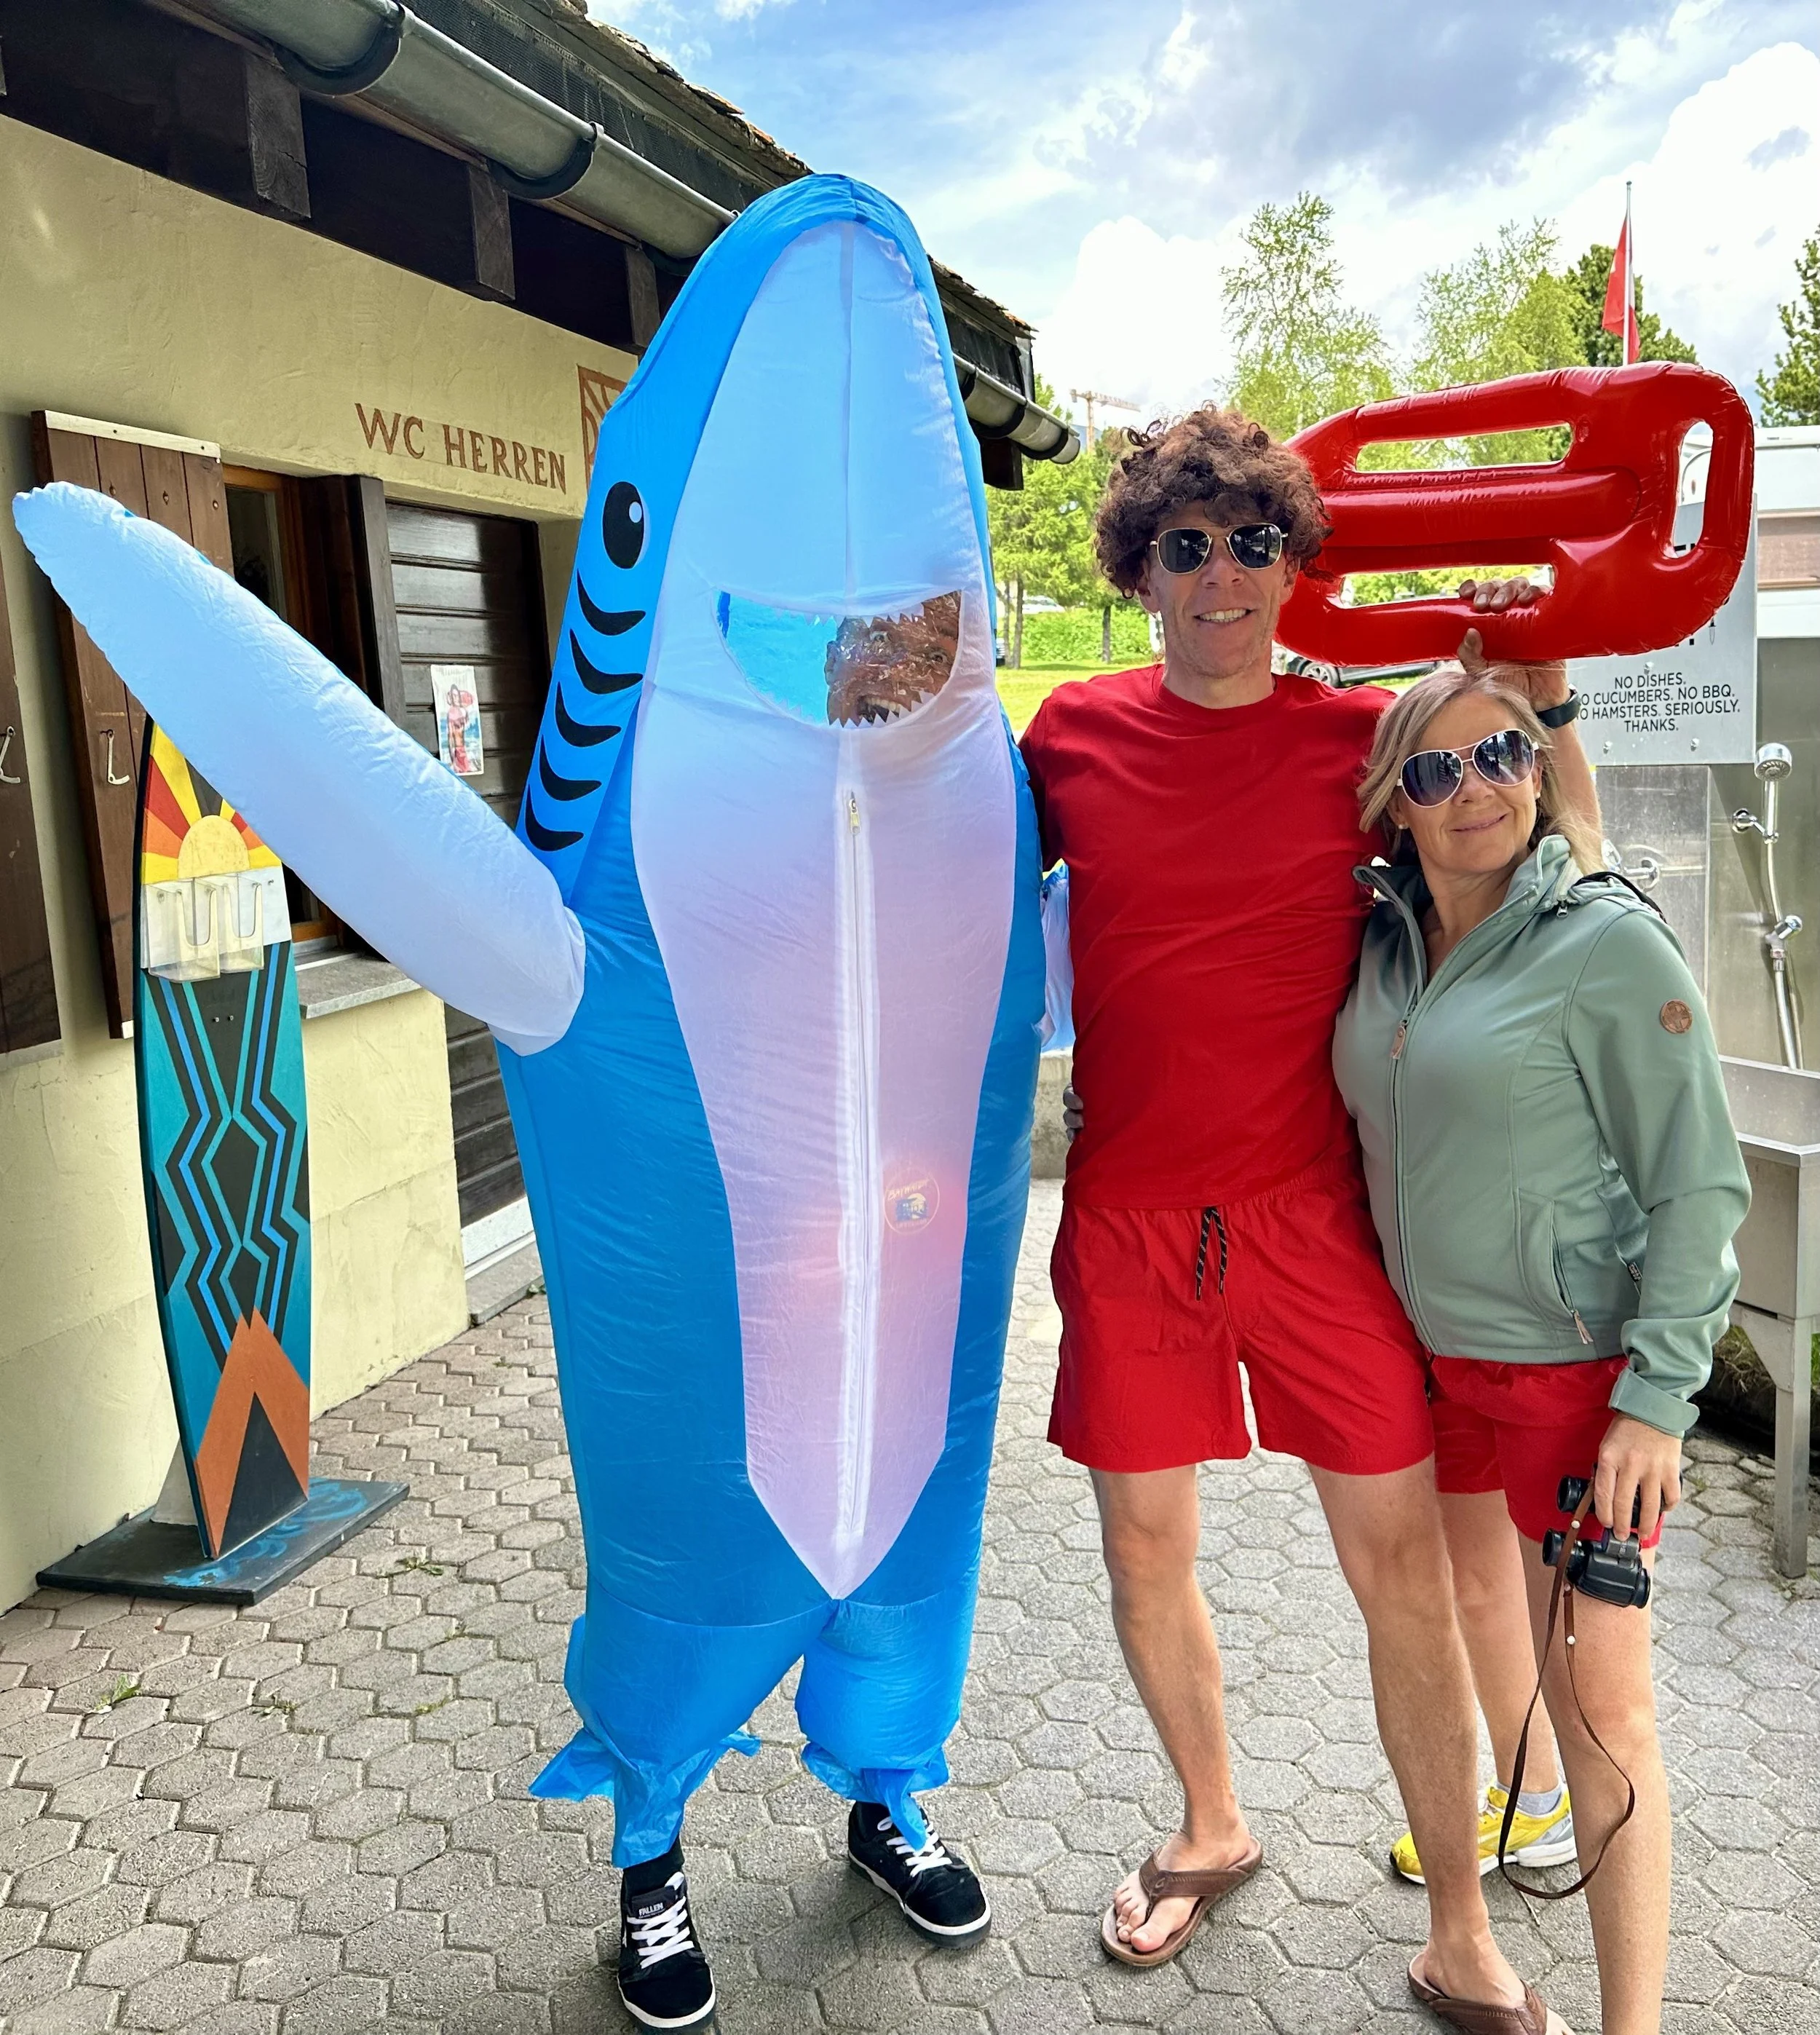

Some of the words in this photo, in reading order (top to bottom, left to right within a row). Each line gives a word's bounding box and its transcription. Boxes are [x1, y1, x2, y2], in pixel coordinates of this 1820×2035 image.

[355, 403, 425, 459] WC
[442, 424, 566, 495] HERREN
[1615, 676, 1633, 689] NO
[1637, 671, 1686, 688] DISHES.
[1580, 693, 1590, 706] O
[1594, 688, 1674, 706] CUCUMBERS.
[1678, 686, 1698, 700] NO
[1702, 684, 1735, 699] BBQ.
[1576, 708, 1589, 720] O
[1592, 704, 1661, 719] HAMSTERS.
[1665, 698, 1741, 716] SERIOUSLY.
[1623, 717, 1679, 732] THANKS.
